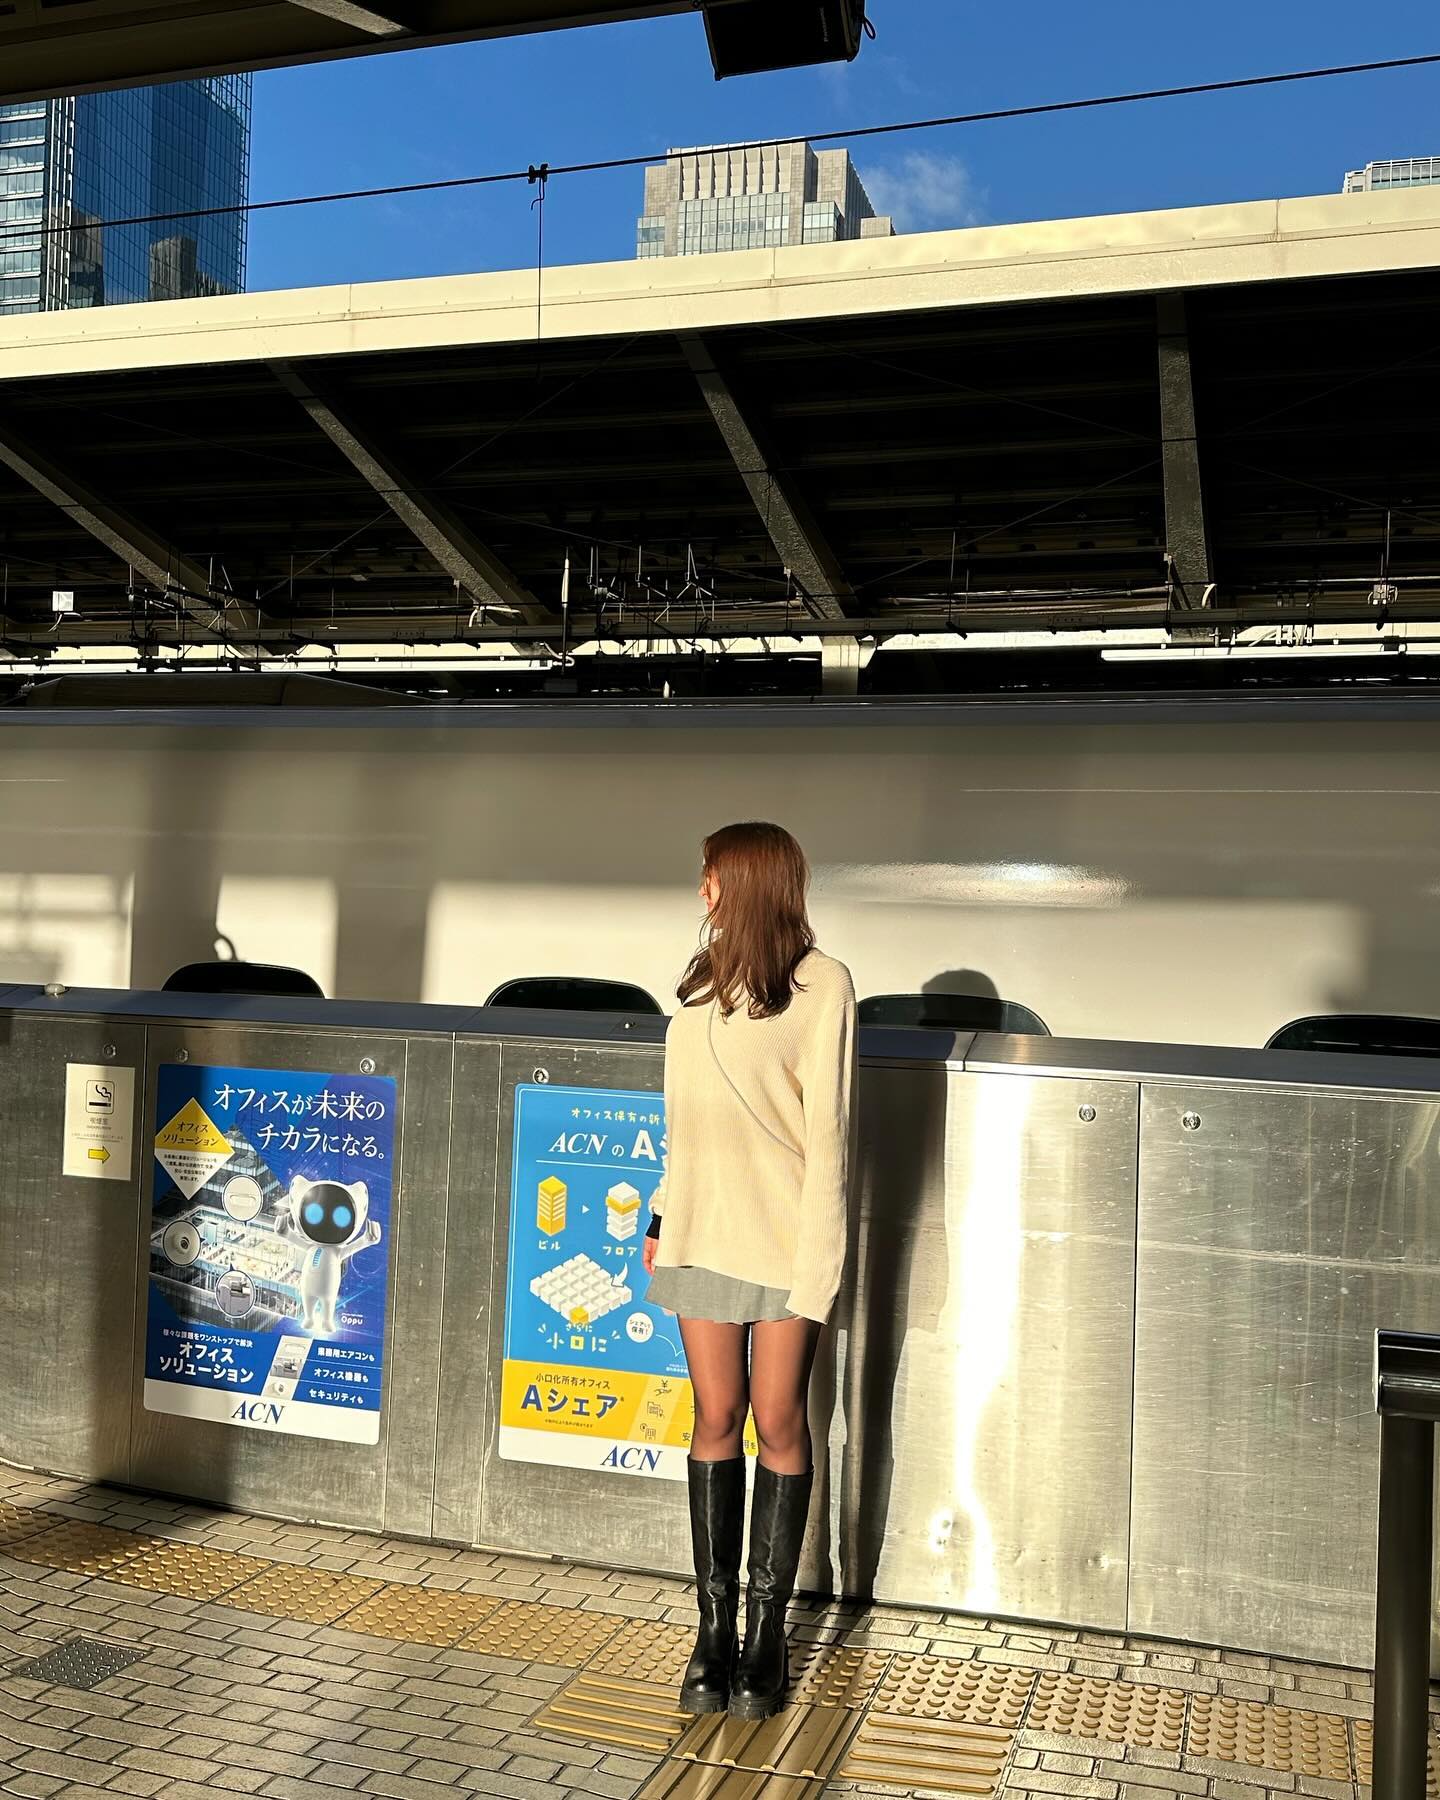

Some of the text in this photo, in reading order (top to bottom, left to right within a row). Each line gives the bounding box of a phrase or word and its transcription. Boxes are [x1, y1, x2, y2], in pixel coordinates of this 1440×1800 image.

[212, 1084, 385, 1121] オフィスが未来の
[176, 1121, 208, 1133] オフィス
[163, 1133, 219, 1146] ソリューション
[256, 1122, 385, 1160] チカラになる。
[538, 1239, 561, 1250] ビル
[602, 1245, 638, 1258] フロア
[341, 1315, 364, 1325] Oppu
[565, 1322, 593, 1333] さらに
[163, 1328, 253, 1348] 様々な課題をワンストップで解決
[179, 1341, 234, 1365] オフィス
[317, 1347, 375, 1362] 業務用エアコンも
[159, 1356, 254, 1383] ソリューション
[313, 1367, 369, 1383] オフィス機器も
[535, 1372, 611, 1390] 小口化所有オフィス
[309, 1388, 364, 1405] セキュリティも
[231, 1400, 287, 1425] ACN
[600, 1445, 664, 1472] ACN
